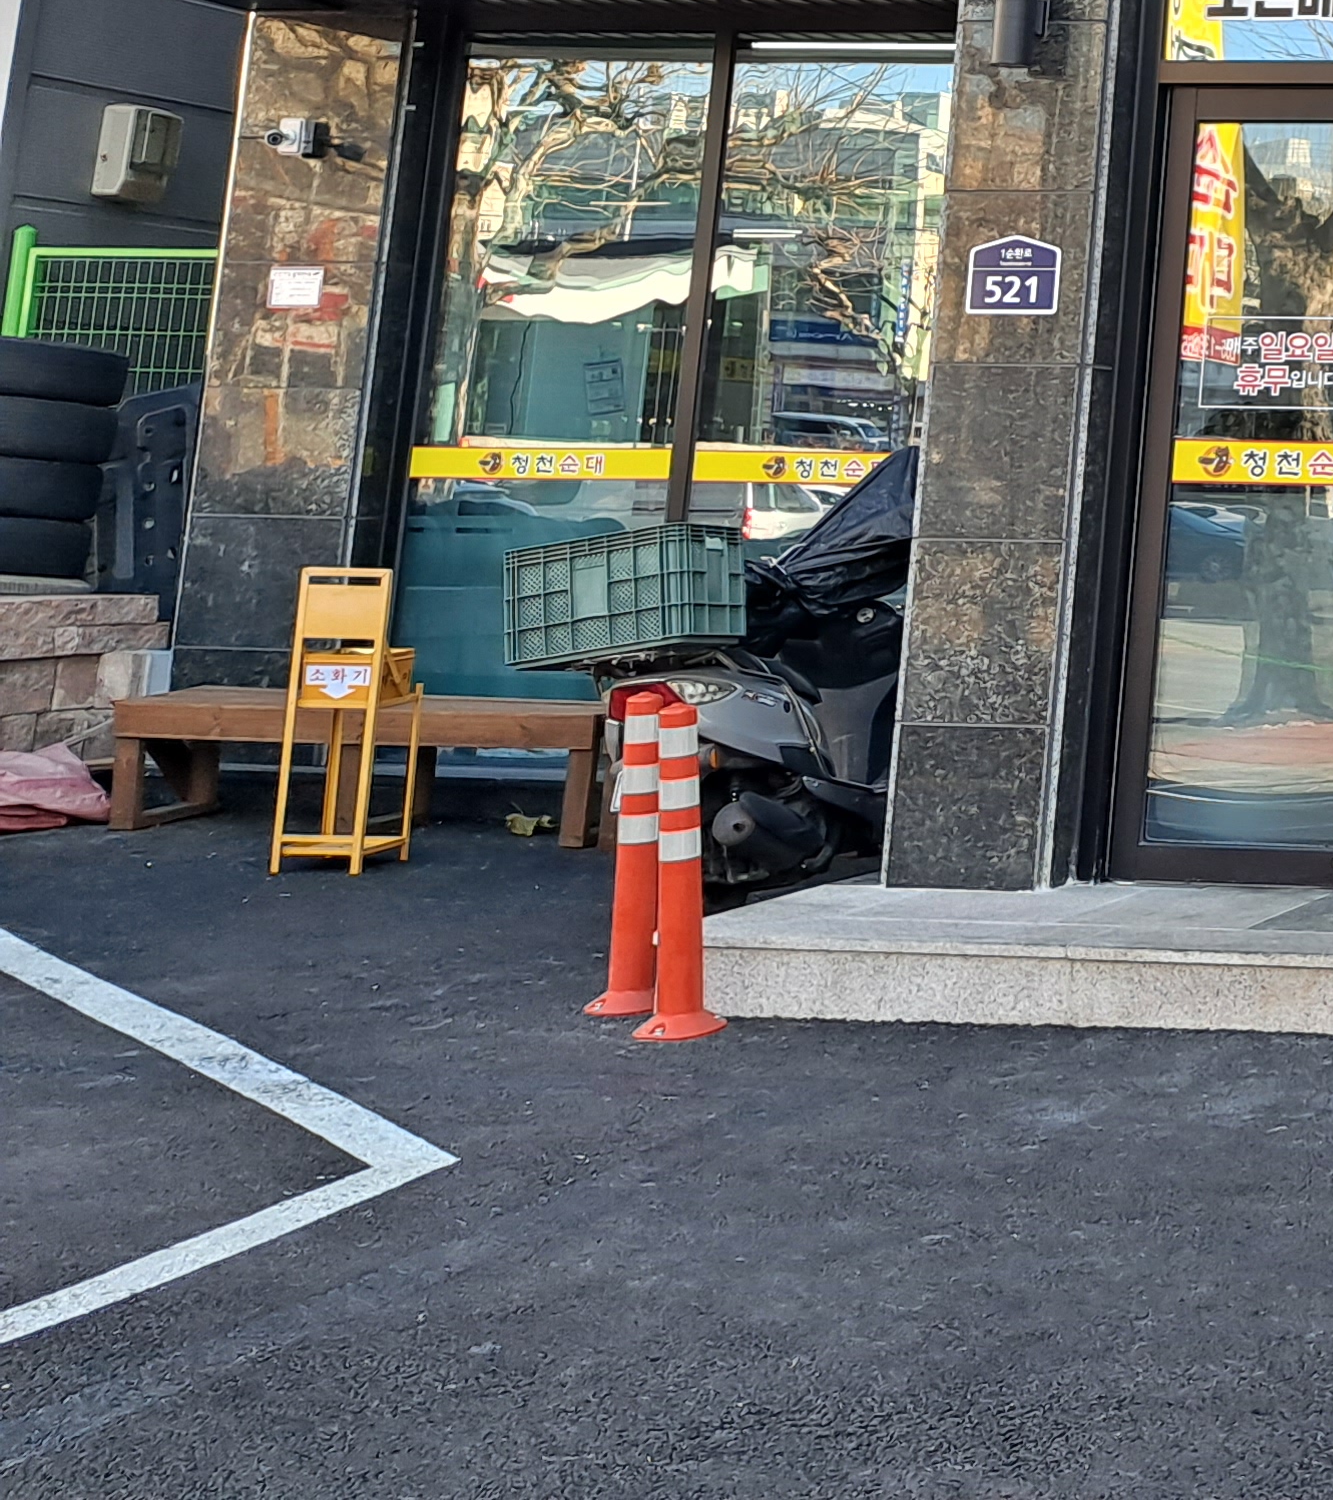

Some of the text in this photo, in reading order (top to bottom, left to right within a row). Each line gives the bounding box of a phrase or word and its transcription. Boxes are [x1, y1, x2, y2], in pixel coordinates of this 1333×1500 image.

[984, 275, 1039, 304] 521
[511, 454, 604, 475] 청천순대
[794, 458, 882, 479] 청천순
[308, 667, 368, 685] 소화기
